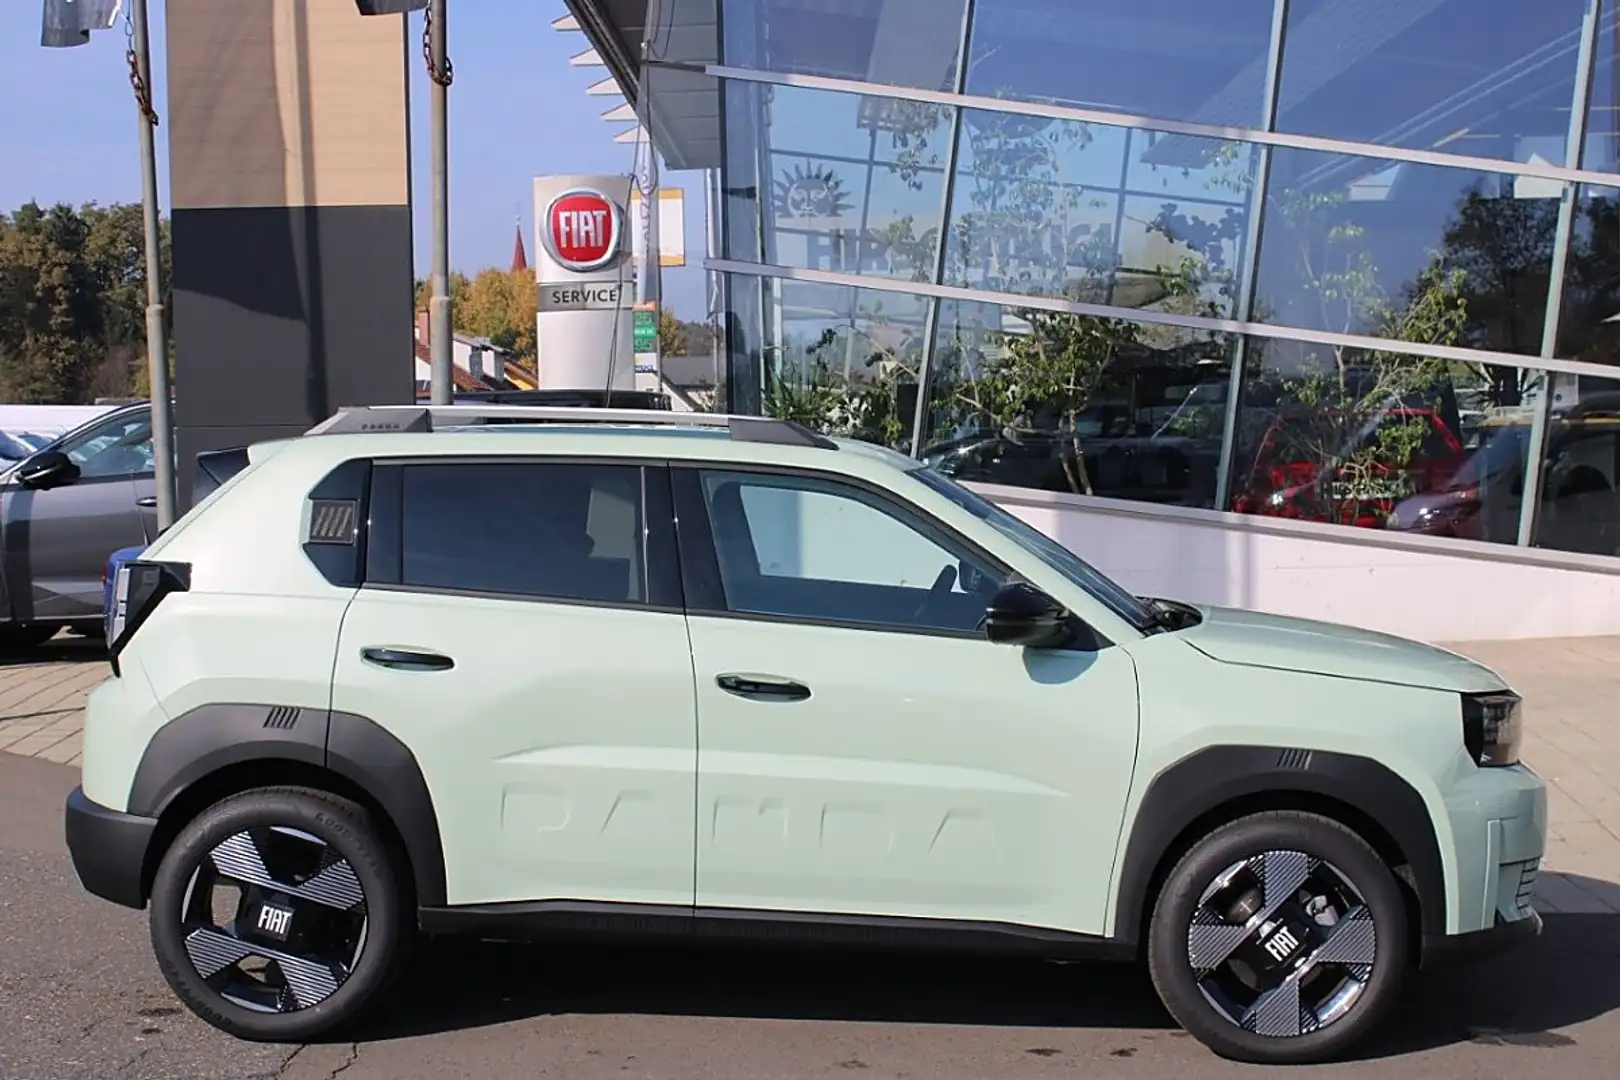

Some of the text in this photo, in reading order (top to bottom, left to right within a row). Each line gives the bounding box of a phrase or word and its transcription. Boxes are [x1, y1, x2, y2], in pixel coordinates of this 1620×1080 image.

[559, 209, 607, 249] FIAT
[552, 289, 617, 304] SERVICE
[258, 905, 292, 935] FIAT
[1264, 926, 1299, 962] FIAT
